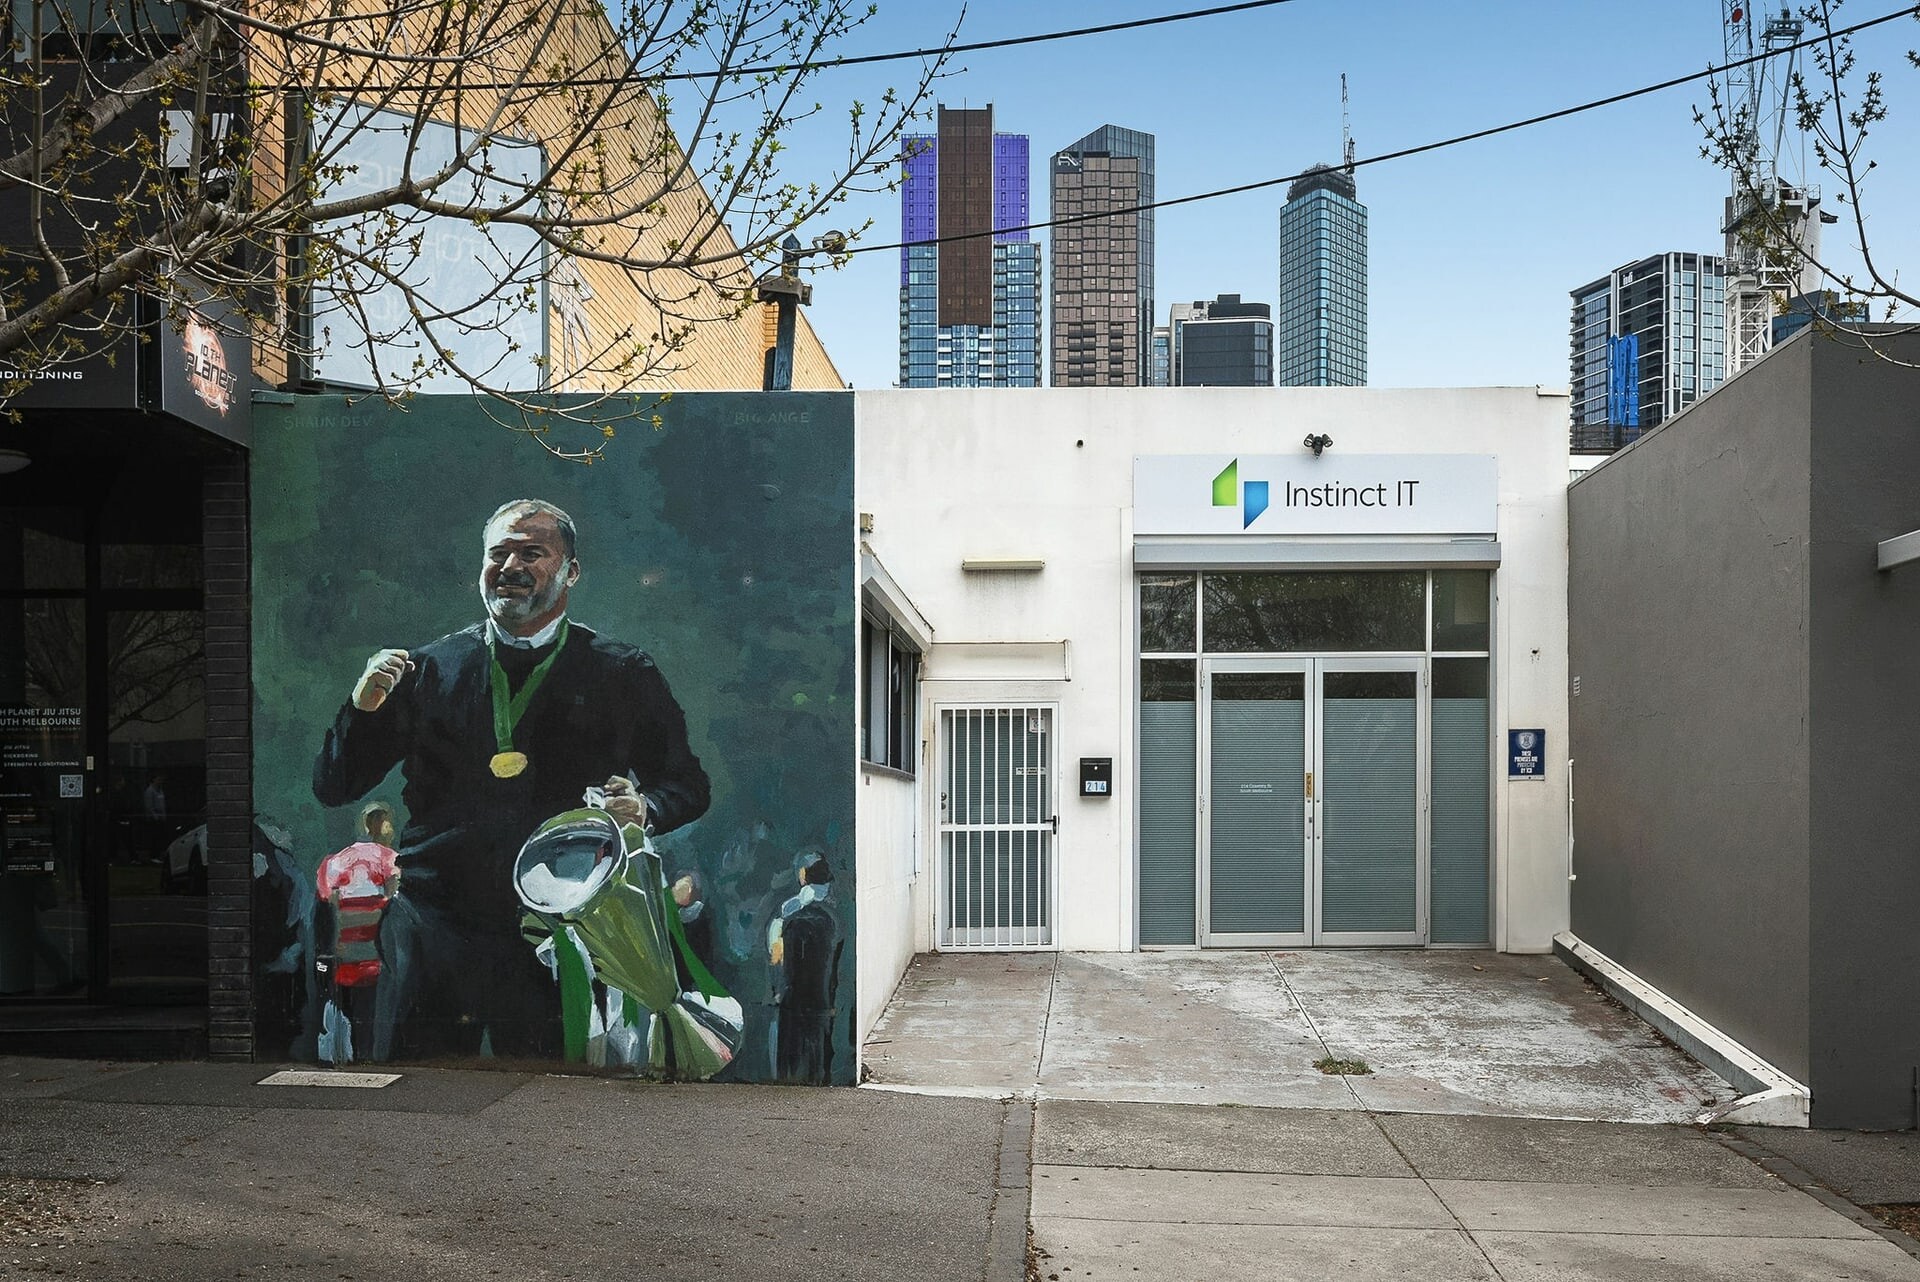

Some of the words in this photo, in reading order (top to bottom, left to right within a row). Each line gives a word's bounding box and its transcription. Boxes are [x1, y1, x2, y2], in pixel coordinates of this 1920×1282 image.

[767, 411, 810, 424] ANGE
[1286, 480, 1387, 507] Instinct
[1397, 480, 1420, 507] IT
[7, 708, 41, 716] PLANET
[42, 708, 56, 716] JIU
[57, 708, 81, 716] JITSU
[22, 717, 81, 726] MELBOURNE
